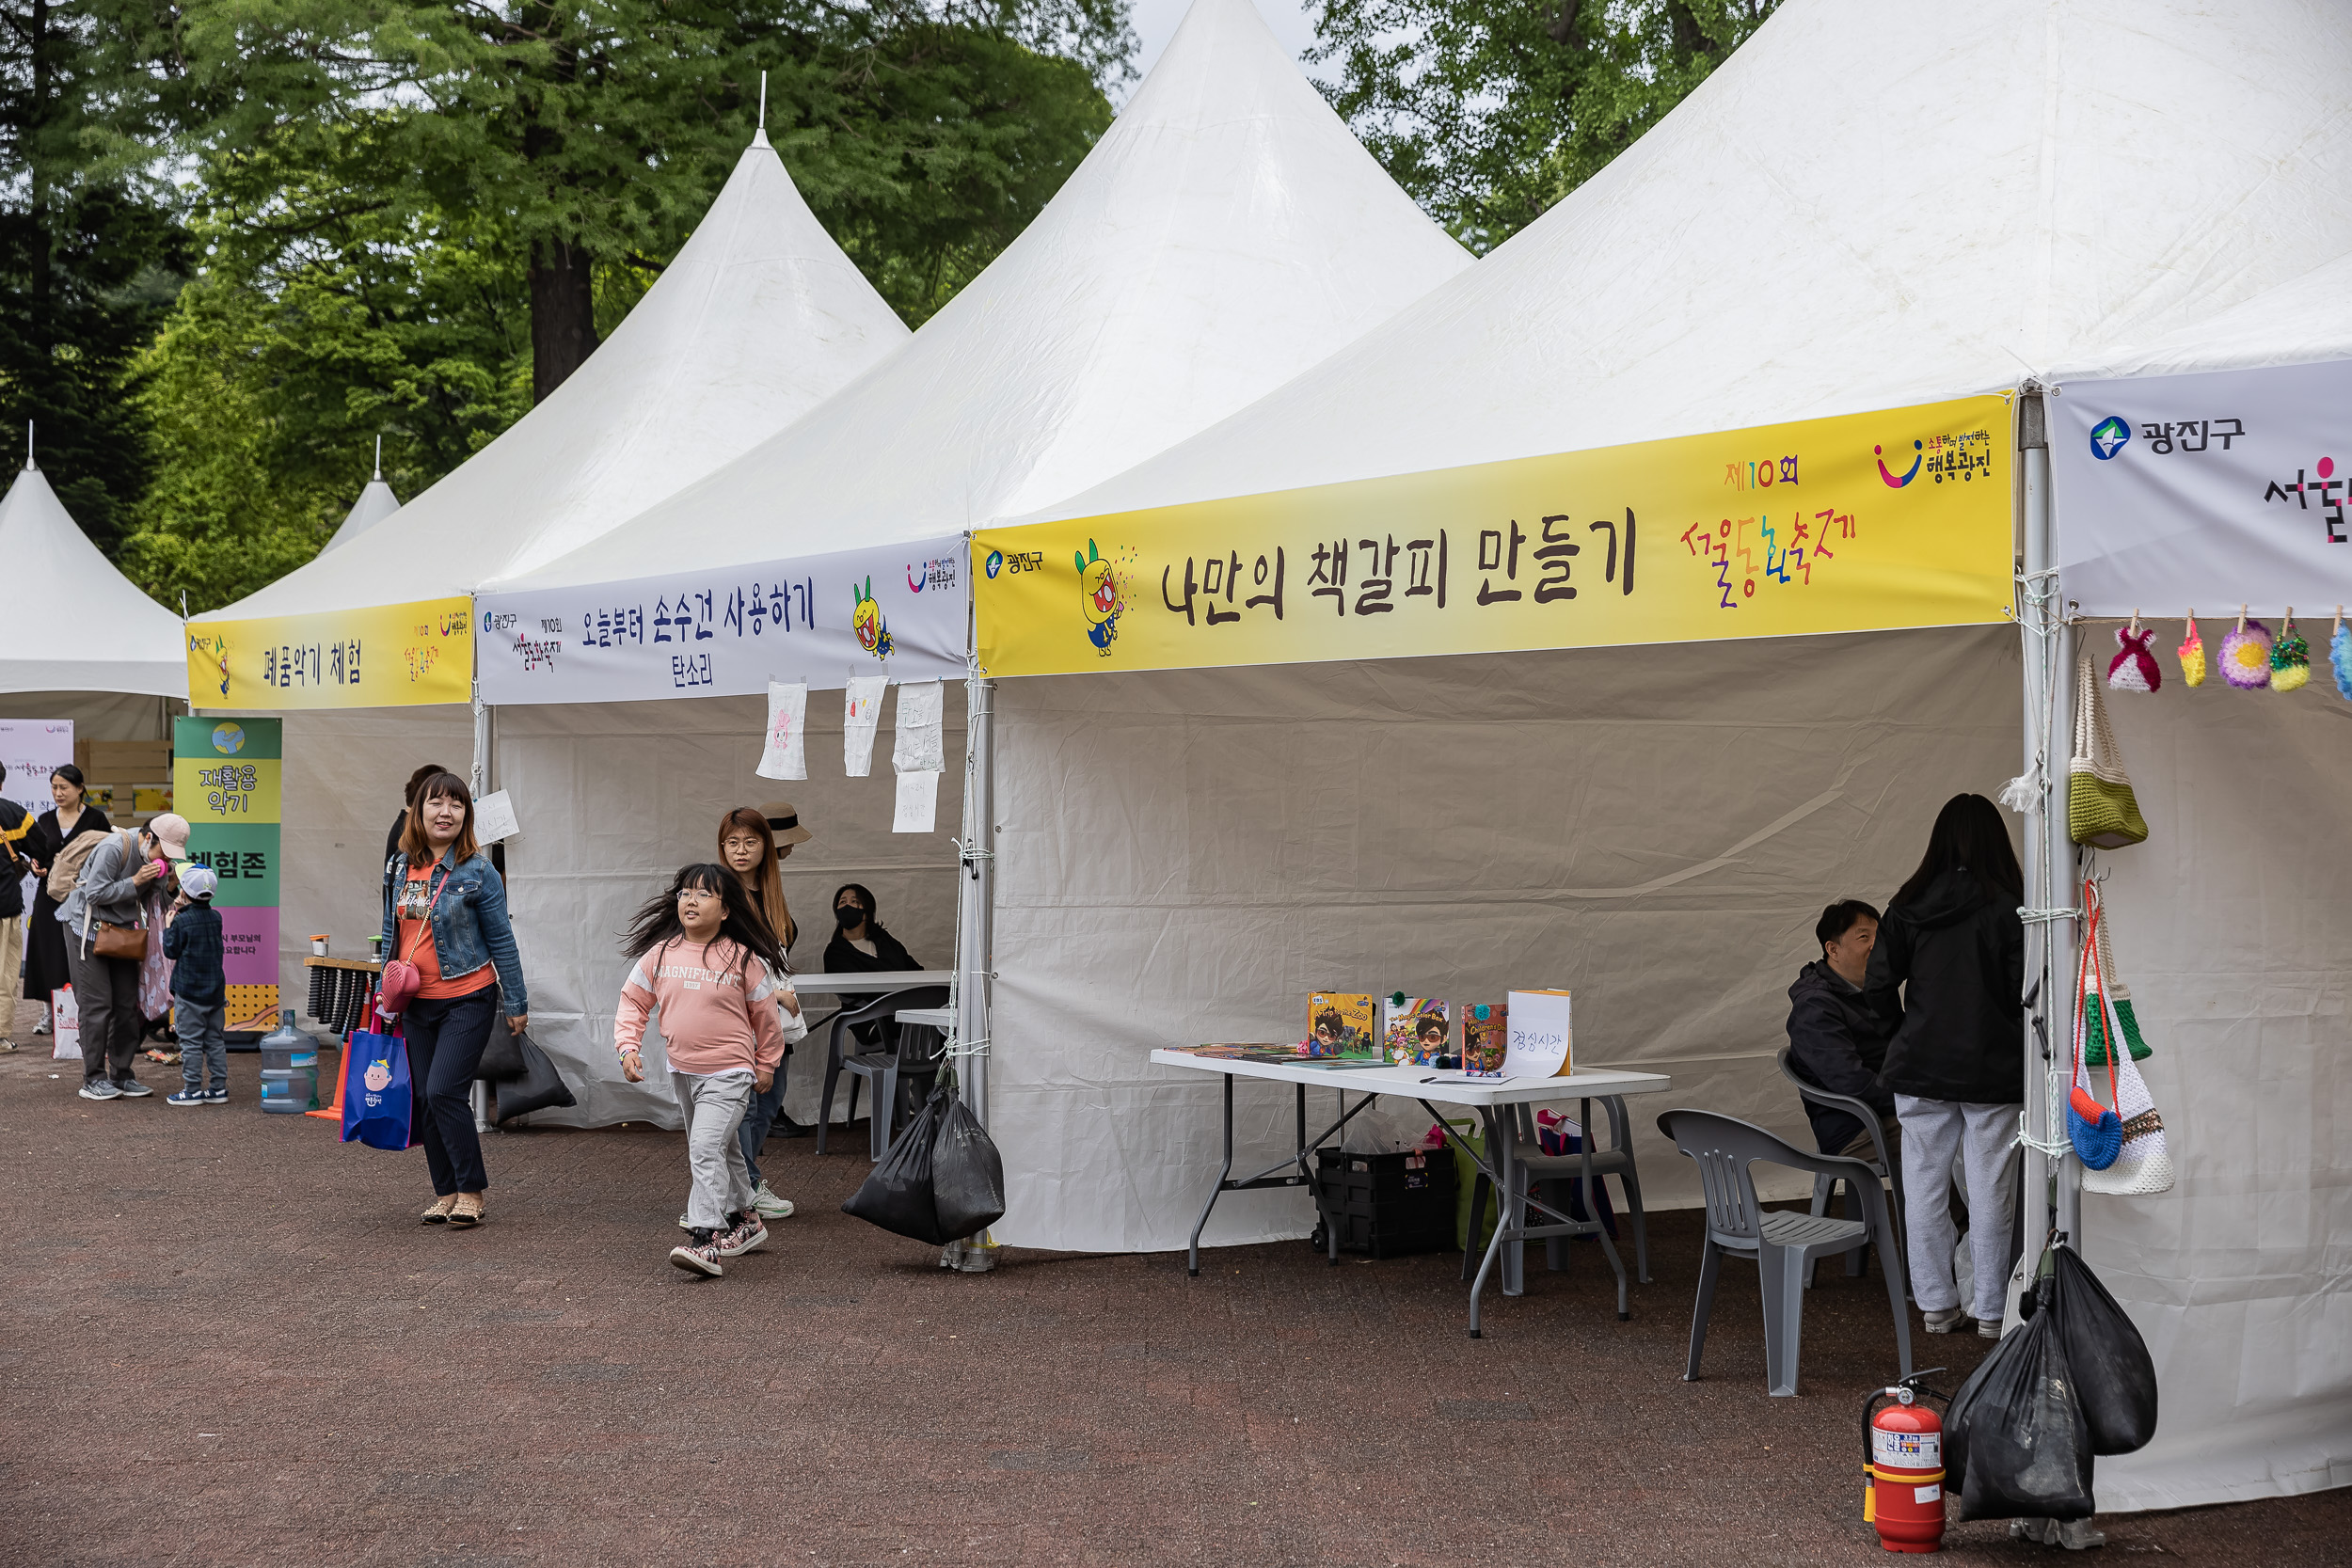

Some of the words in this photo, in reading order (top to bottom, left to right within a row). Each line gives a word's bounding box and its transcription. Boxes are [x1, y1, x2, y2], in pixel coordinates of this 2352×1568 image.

[1928, 434, 1957, 454] 소통하며
[1958, 429, 1990, 451] 발전하는
[2140, 418, 2246, 455] 광진구
[1724, 453, 1799, 491] 제10회
[1927, 449, 1990, 483] 행복광진
[2264, 456, 2352, 544] 서울
[1007, 550, 1043, 574] 광진구
[1162, 546, 1285, 626] 나만의
[1307, 528, 1448, 617] 책갈피
[1476, 506, 1636, 606] 만들기
[494, 613, 516, 630] 광진구
[582, 604, 644, 648] 오늘부터
[653, 588, 713, 643] 손수건
[723, 576, 815, 637] 사용하기
[541, 617, 562, 633] 제10회
[263, 642, 320, 687] 폐품악기
[330, 639, 361, 685] 체험
[672, 653, 713, 688] 탄소리
[199, 765, 258, 791] 재활용
[208, 791, 247, 816] 악기
[224, 945, 256, 956] 요합니다
[230, 934, 262, 943] 부모님의
[654, 966, 741, 988] MAGNIFICENT
[1321, 1008, 1334, 1019] Trip
[1351, 1008, 1368, 1022] Zoo
[1398, 1013, 1415, 1022] Magic
[1415, 1010, 1431, 1019] Color
[1431, 1012, 1444, 1023] Box
[1470, 1023, 1497, 1035] Children's
[1513, 1030, 1563, 1055] 점심시간
